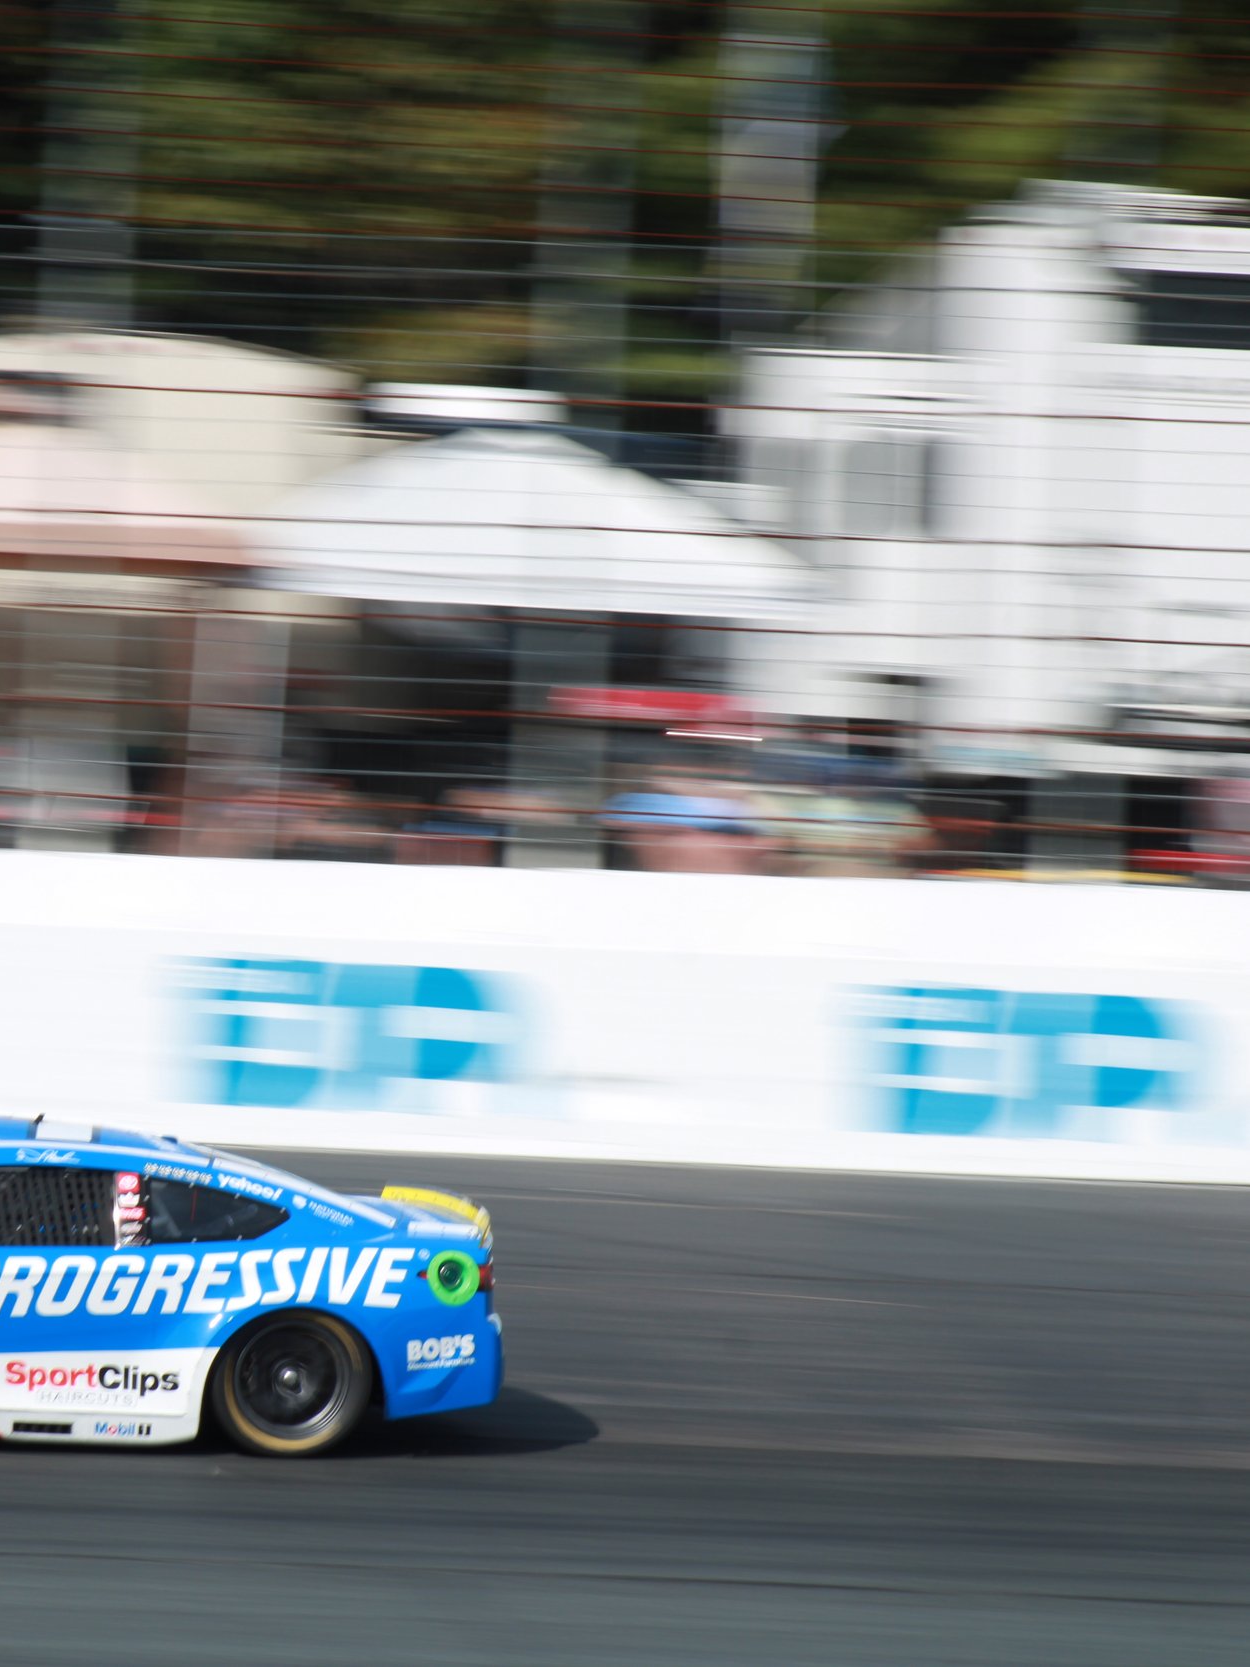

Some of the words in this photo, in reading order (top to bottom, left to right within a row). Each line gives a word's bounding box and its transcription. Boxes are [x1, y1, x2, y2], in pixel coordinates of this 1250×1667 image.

[406, 1333, 476, 1362] BOB'S
[5, 1360, 180, 1397] SportClips
[95, 1422, 136, 1436] Mobil
